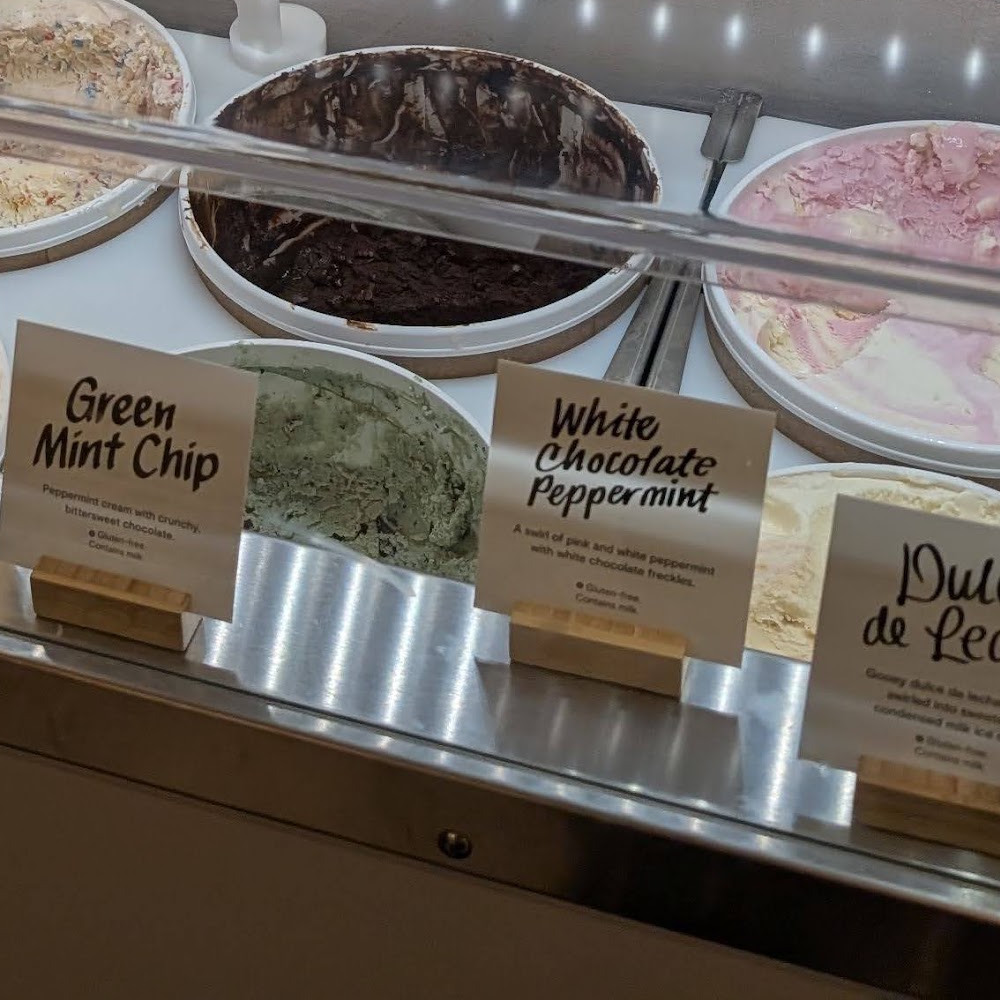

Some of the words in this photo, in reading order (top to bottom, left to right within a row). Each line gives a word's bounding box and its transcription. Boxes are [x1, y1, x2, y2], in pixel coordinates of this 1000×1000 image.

[66, 376, 177, 431] Green
[551, 397, 660, 441] White
[33, 423, 126, 470] Mint
[132, 433, 220, 492] Chip
[535, 438, 718, 478] Chocolate
[43, 484, 99, 507] Peppermint
[101, 500, 132, 514] cream
[134, 508, 156, 521] with
[65, 504, 120, 527] bittersweet
[527, 474, 720, 519] Peppermint
[897, 542, 1000, 606] Dul
[862, 605, 910, 648] de
